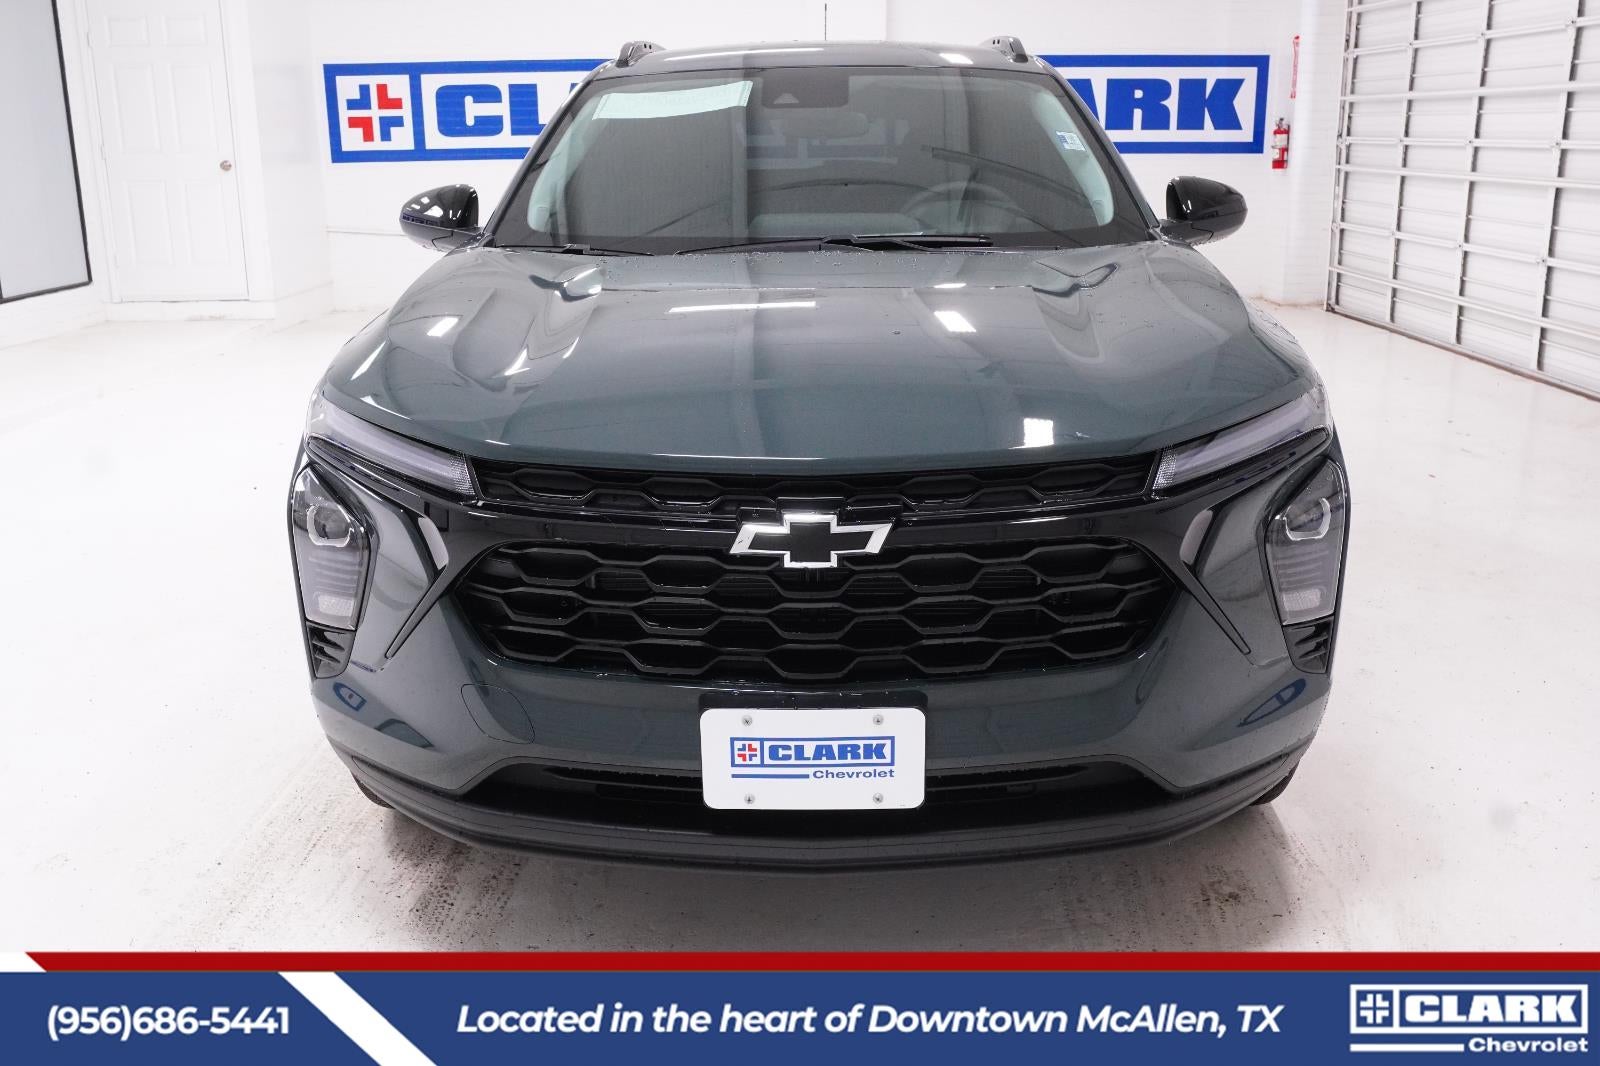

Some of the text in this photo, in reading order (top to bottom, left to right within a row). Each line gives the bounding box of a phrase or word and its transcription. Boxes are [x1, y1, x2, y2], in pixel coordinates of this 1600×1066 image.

[435, 83, 577, 138] CL
[768, 743, 886, 762] CLARK
[812, 769, 895, 779] Chevrolet
